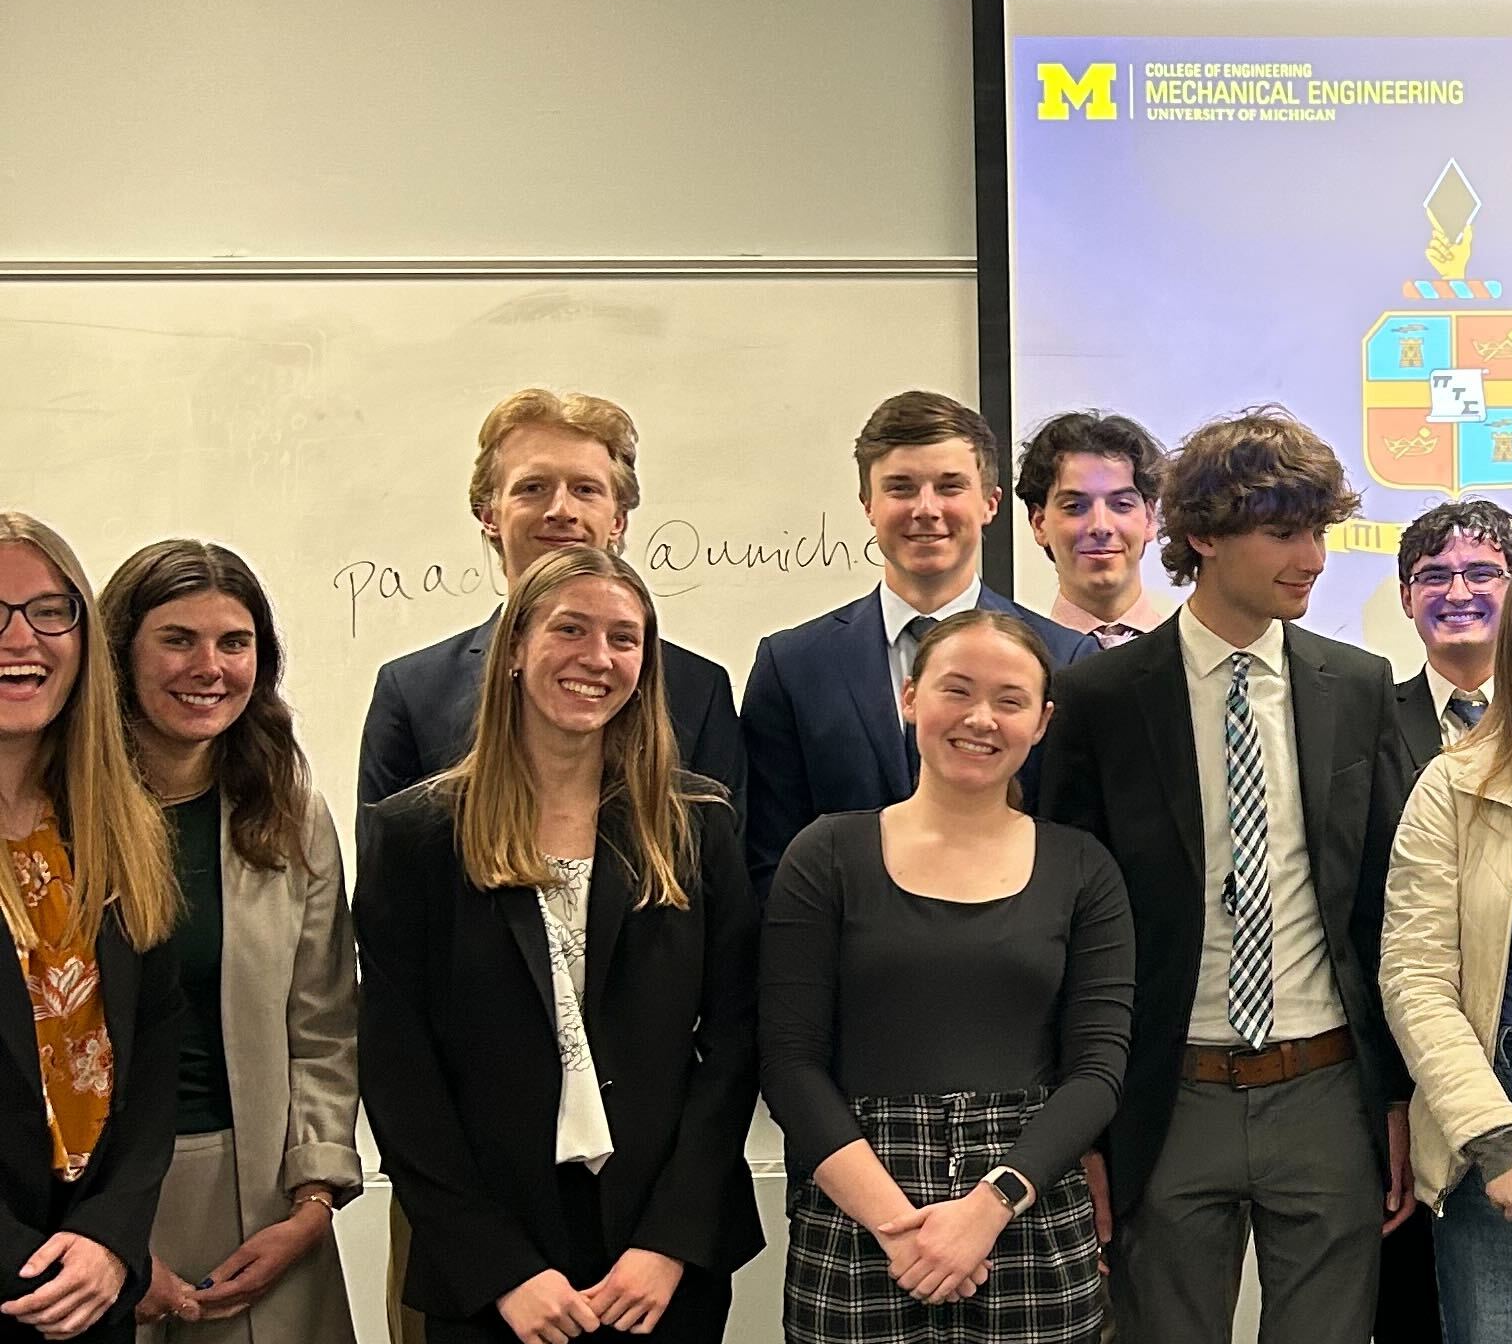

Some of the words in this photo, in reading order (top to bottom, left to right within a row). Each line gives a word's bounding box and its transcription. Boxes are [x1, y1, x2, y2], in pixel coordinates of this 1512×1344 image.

[1145, 63, 1201, 78] COLLEGE
[1204, 63, 1221, 78] OF
[1223, 63, 1312, 78] ENGINEERING
[1037, 63, 1117, 120] M
[1145, 80, 1300, 105] MECHANICAL
[1308, 80, 1465, 105] ENGINEERING
[1147, 108, 1234, 121] UNIVERSITY
[1237, 108, 1257, 121] OF
[1259, 108, 1336, 121] MICHIGAN
